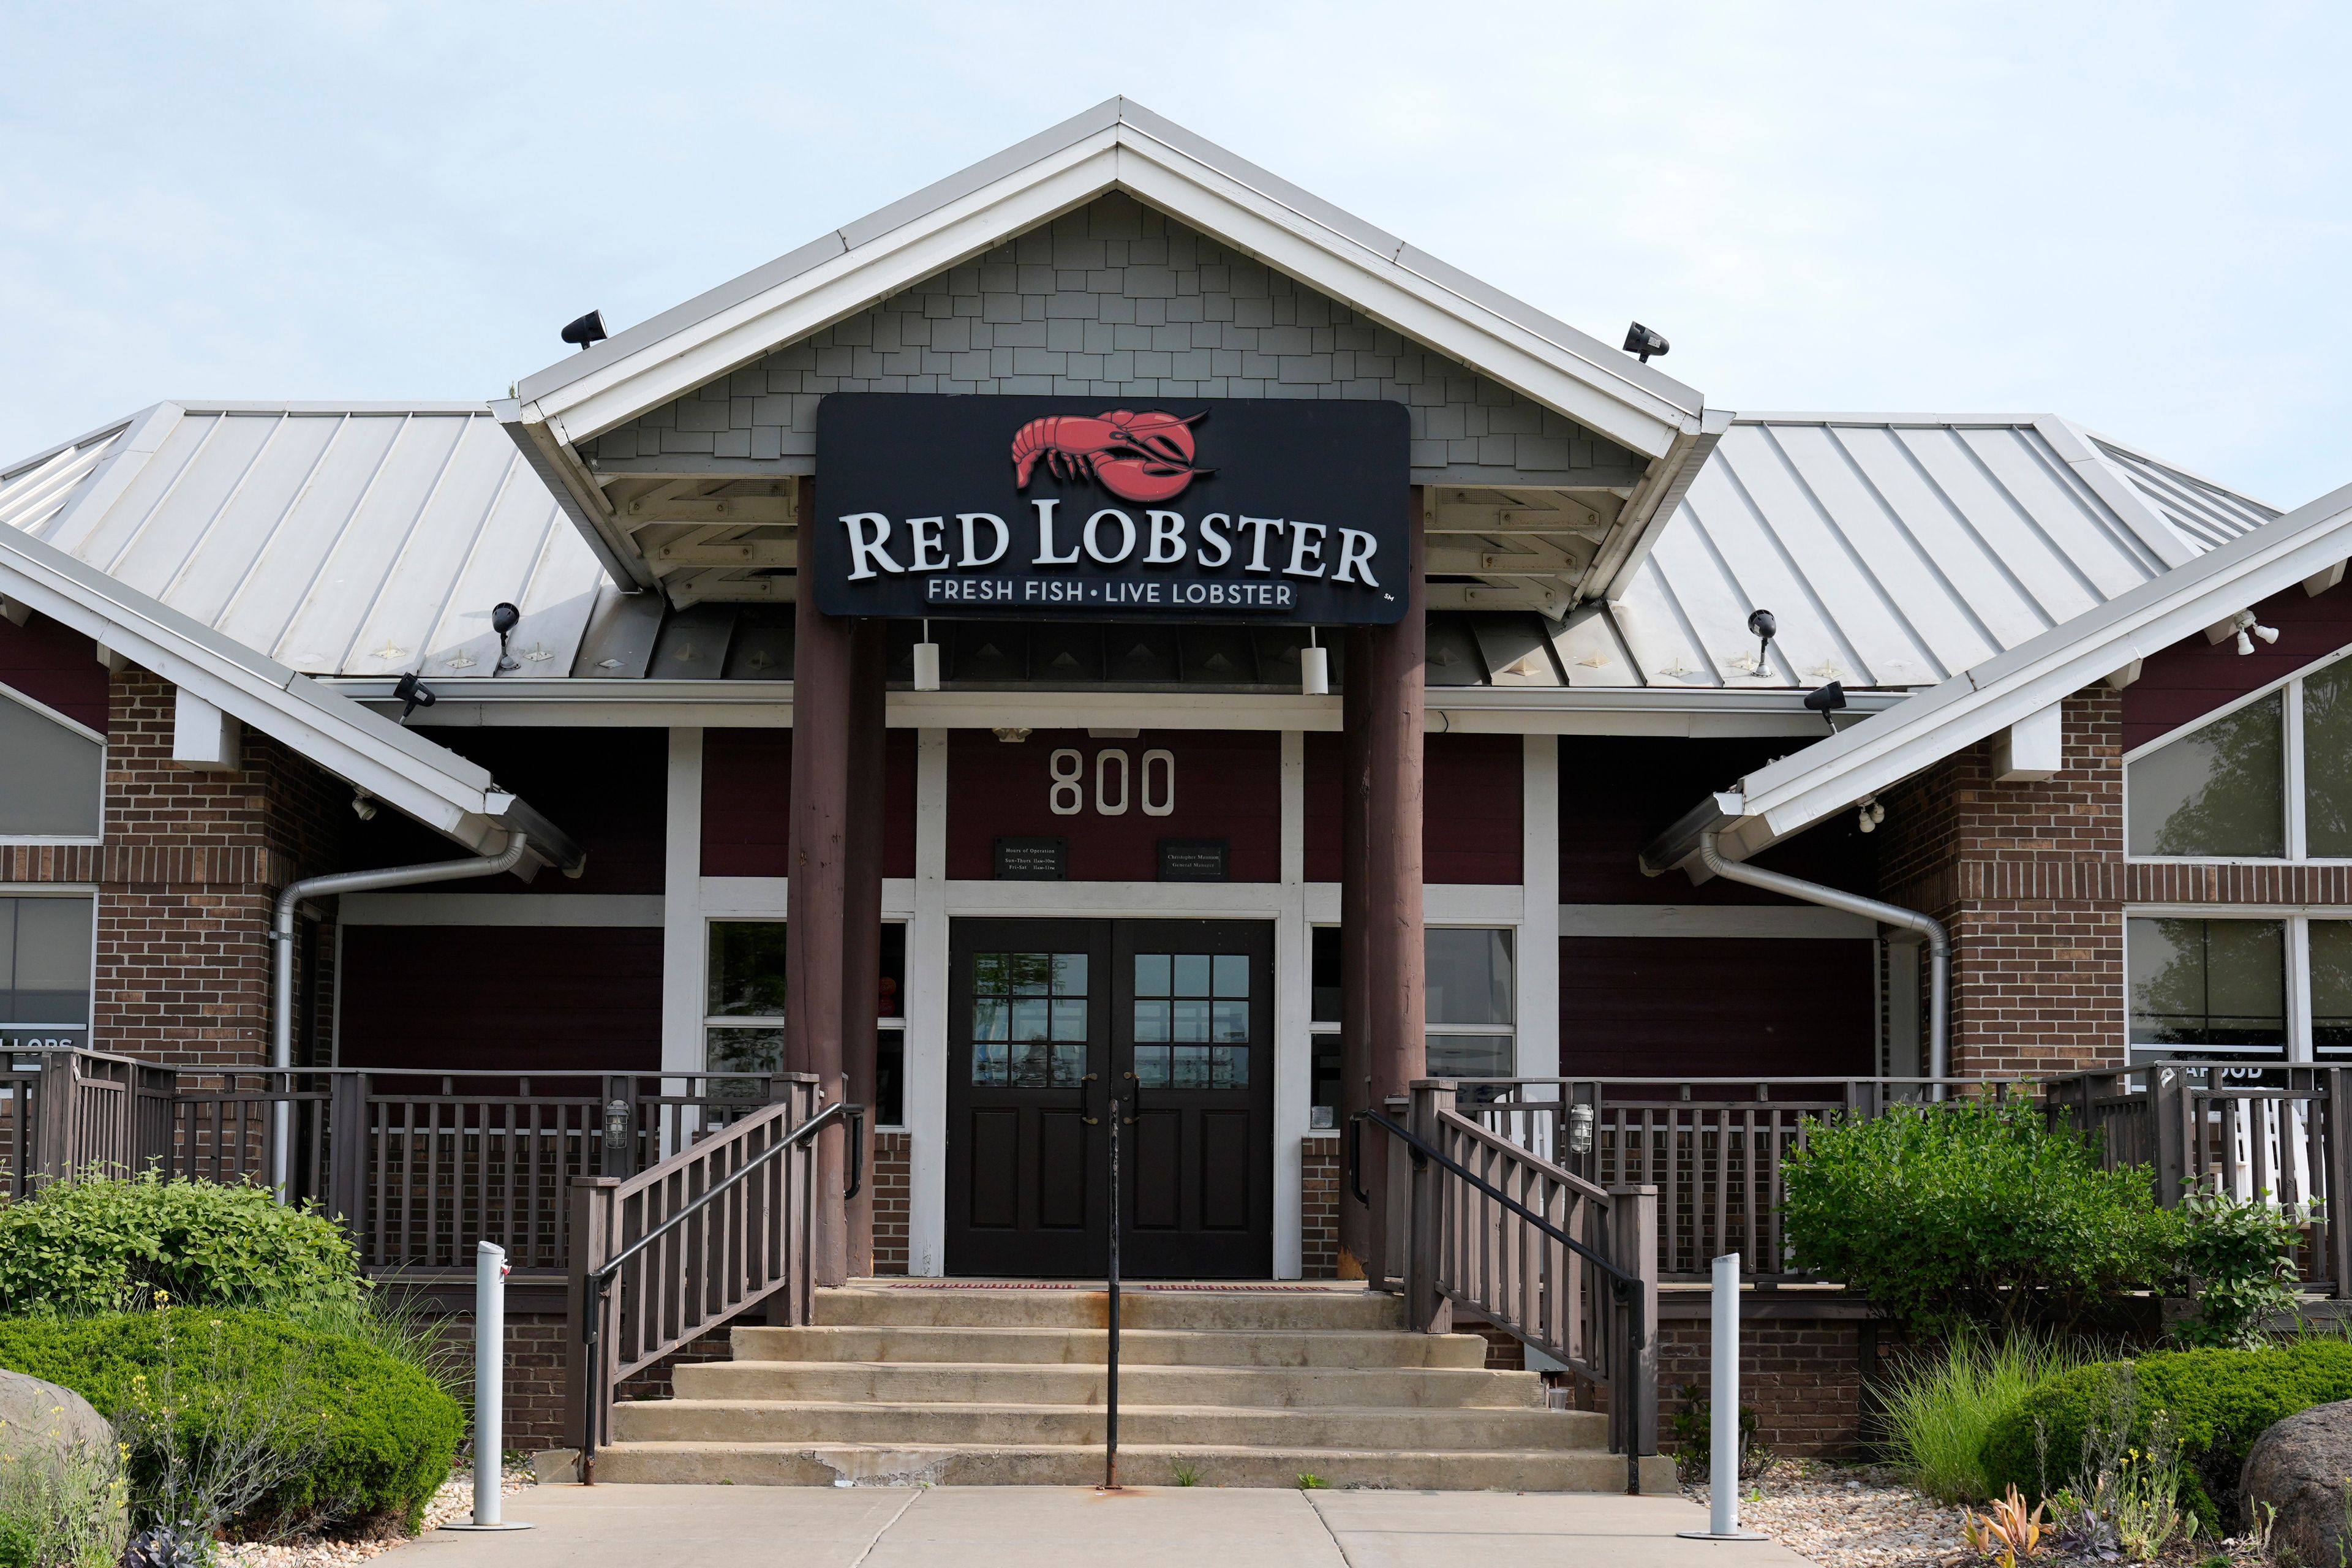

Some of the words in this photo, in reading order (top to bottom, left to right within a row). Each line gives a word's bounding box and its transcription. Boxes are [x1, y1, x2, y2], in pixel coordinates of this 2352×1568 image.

[839, 512, 1010, 581] RED
[1031, 499, 1379, 588] LOBSTER
[929, 579, 1012, 600] FRESH
[1025, 581, 1082, 601] FISH
[1106, 582, 1160, 603] LIVE
[1173, 584, 1291, 605] LOBSTER
[1384, 593, 1395, 601] SM
[1050, 748, 1174, 816] 800
